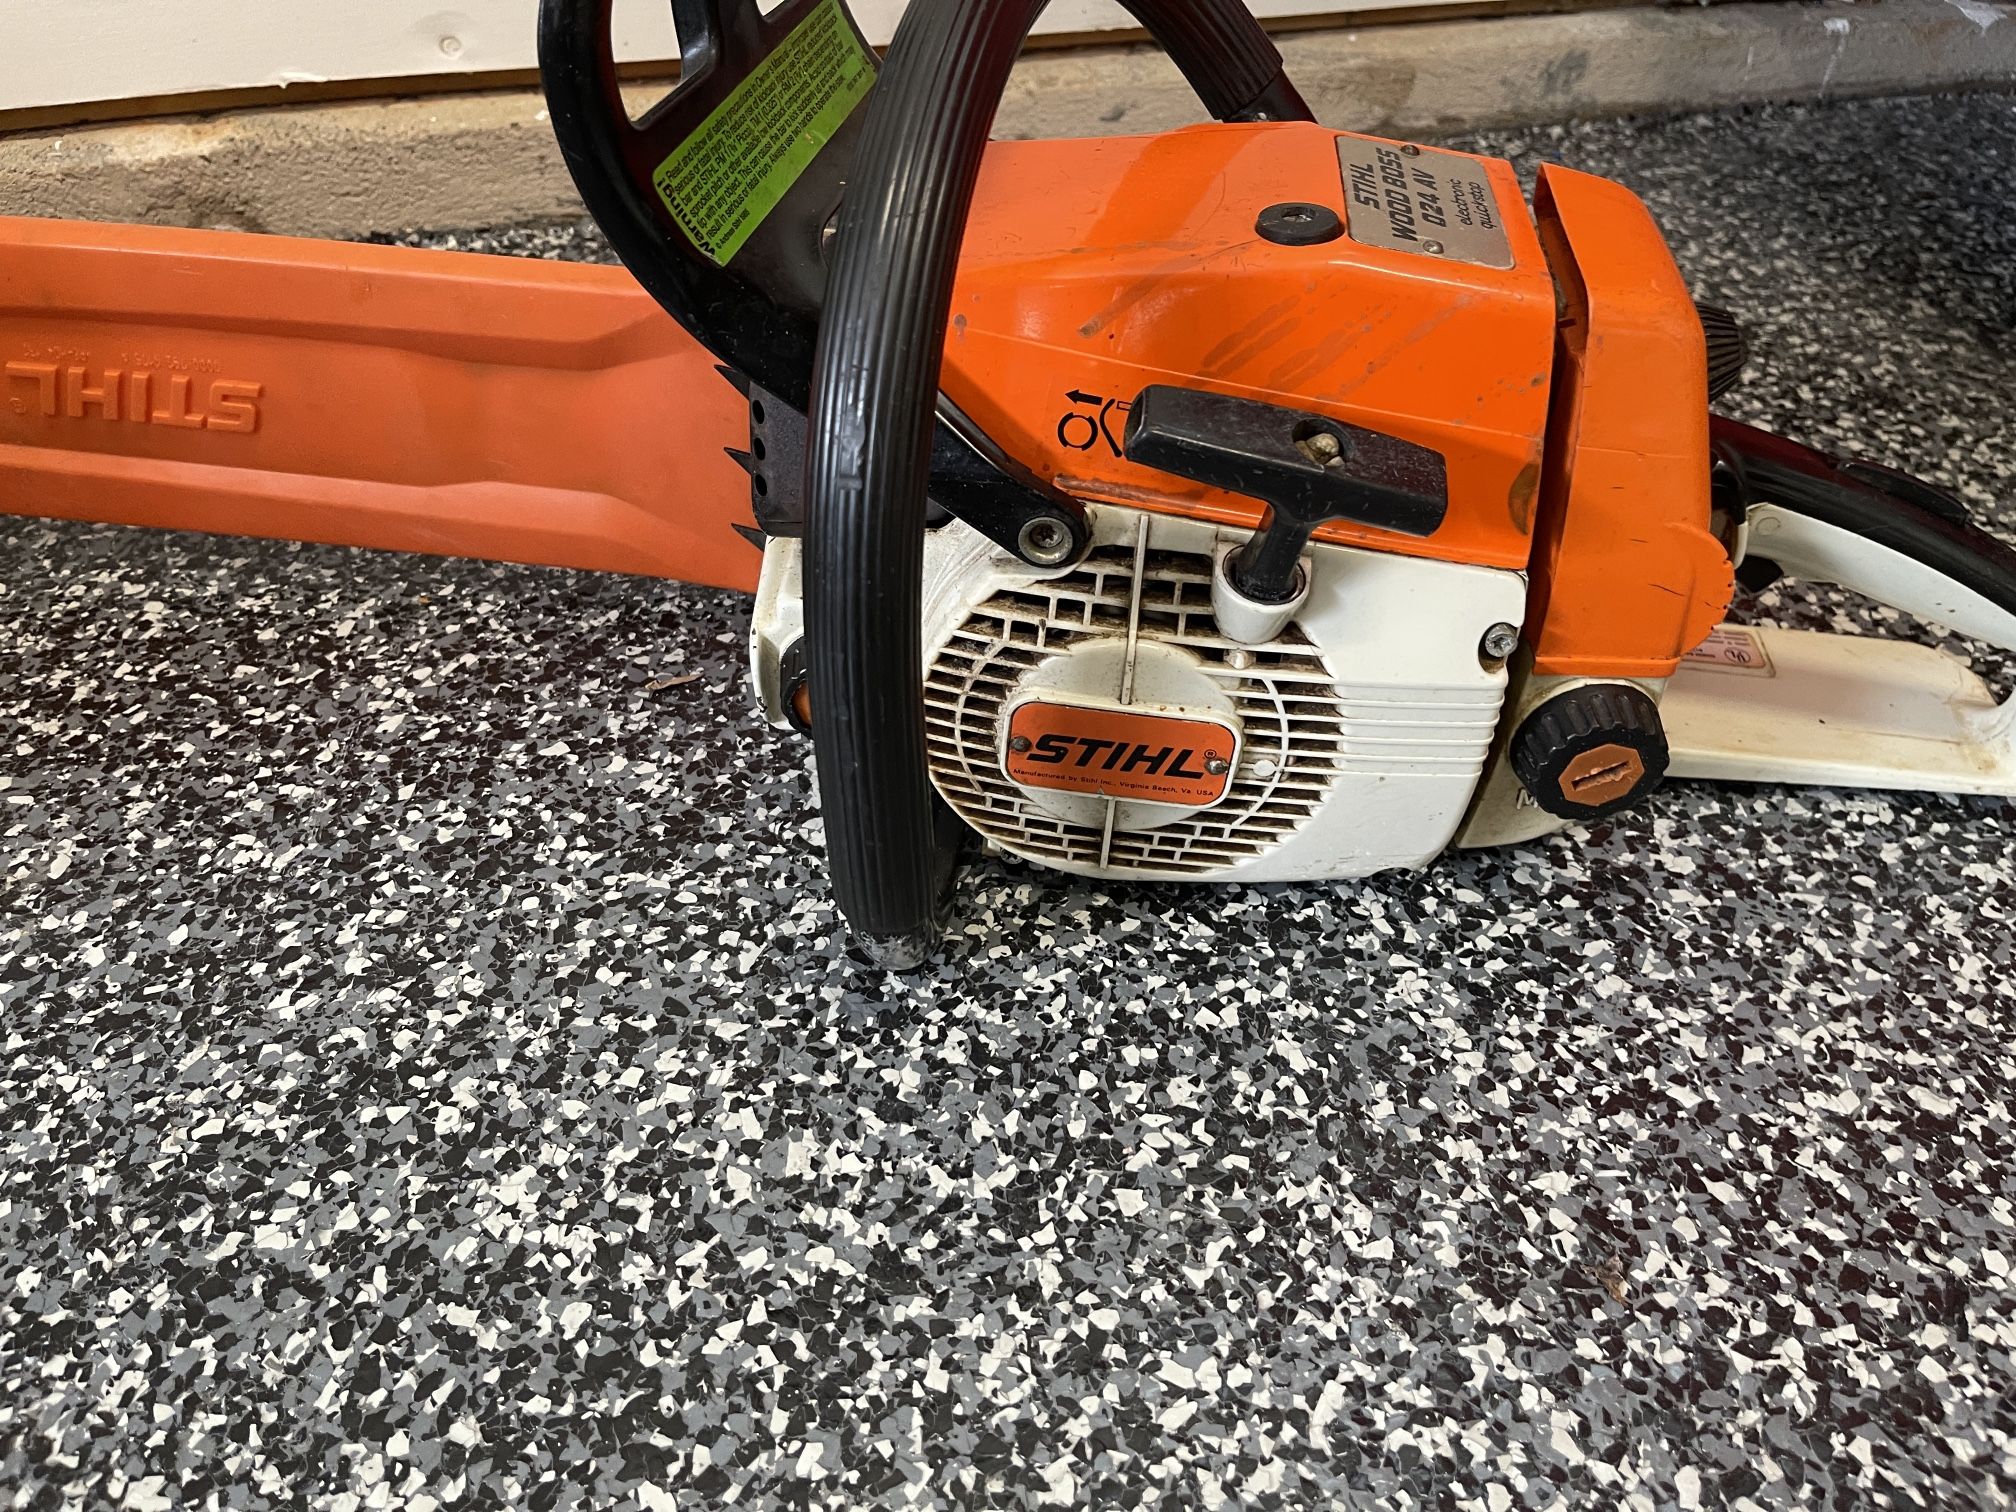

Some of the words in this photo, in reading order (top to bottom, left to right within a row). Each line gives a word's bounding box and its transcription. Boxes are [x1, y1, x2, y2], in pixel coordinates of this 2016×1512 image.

[1350, 164, 1380, 210] STIHL
[1376, 148, 1408, 191] BOSS
[1411, 167, 1438, 191] AV
[1384, 189, 1418, 242] WOOD
[1417, 192, 1447, 228] 024
[1448, 179, 1473, 226] electronic
[1468, 182, 1497, 230] quickstop
[5, 361, 262, 433] STIHL
[1026, 734, 1204, 780] STIHL
[1013, 768, 1066, 780] Manufactured
[1080, 776, 1098, 784] Stihl
[1120, 782, 1149, 790] Virginia
[1196, 789, 1214, 797] USA
